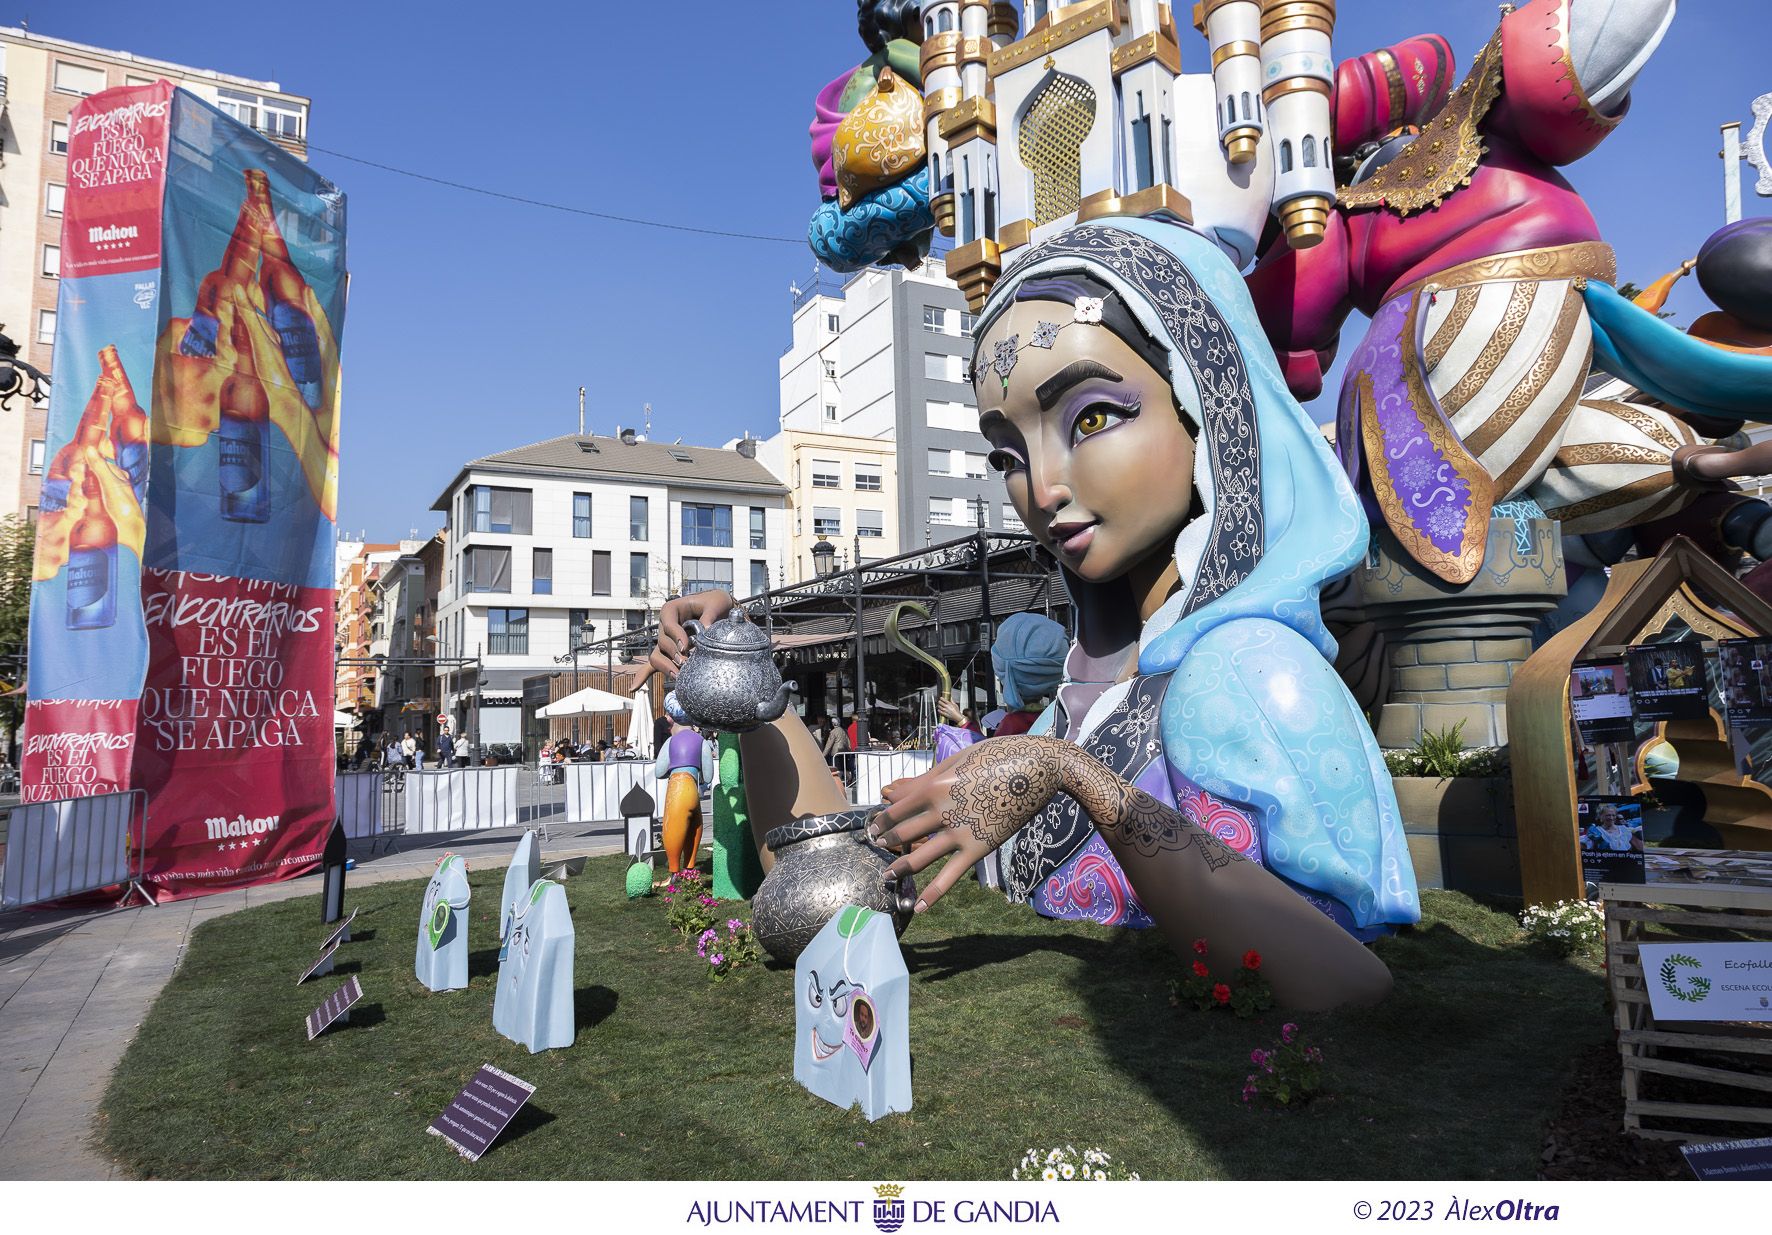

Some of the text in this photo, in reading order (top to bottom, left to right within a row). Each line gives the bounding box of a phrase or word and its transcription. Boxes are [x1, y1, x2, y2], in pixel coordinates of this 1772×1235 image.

[73, 101, 168, 136] ENCONTRARNOS
[101, 121, 139, 141] ES EL
[93, 134, 145, 158] FUEGO
[72, 146, 162, 178] QUE NUNCA
[80, 163, 152, 188] SE APAGA
[88, 224, 138, 243] Mahou
[144, 592, 323, 637] ENCONTRARNOS
[196, 625, 278, 658] ES EL
[179, 656, 284, 688] FUEGO
[142, 687, 320, 726] QUE NUNCA
[26, 732, 133, 756] ENCONTRARNOS
[156, 719, 303, 751] SE APAGA
[47, 749, 92, 767] ES EL
[41, 766, 97, 784] FUEGO
[23, 784, 53, 803] QUE
[204, 814, 280, 840] Mahou
[215, 866, 235, 877] vida
[1720, 984, 1751, 992] ESCENA
